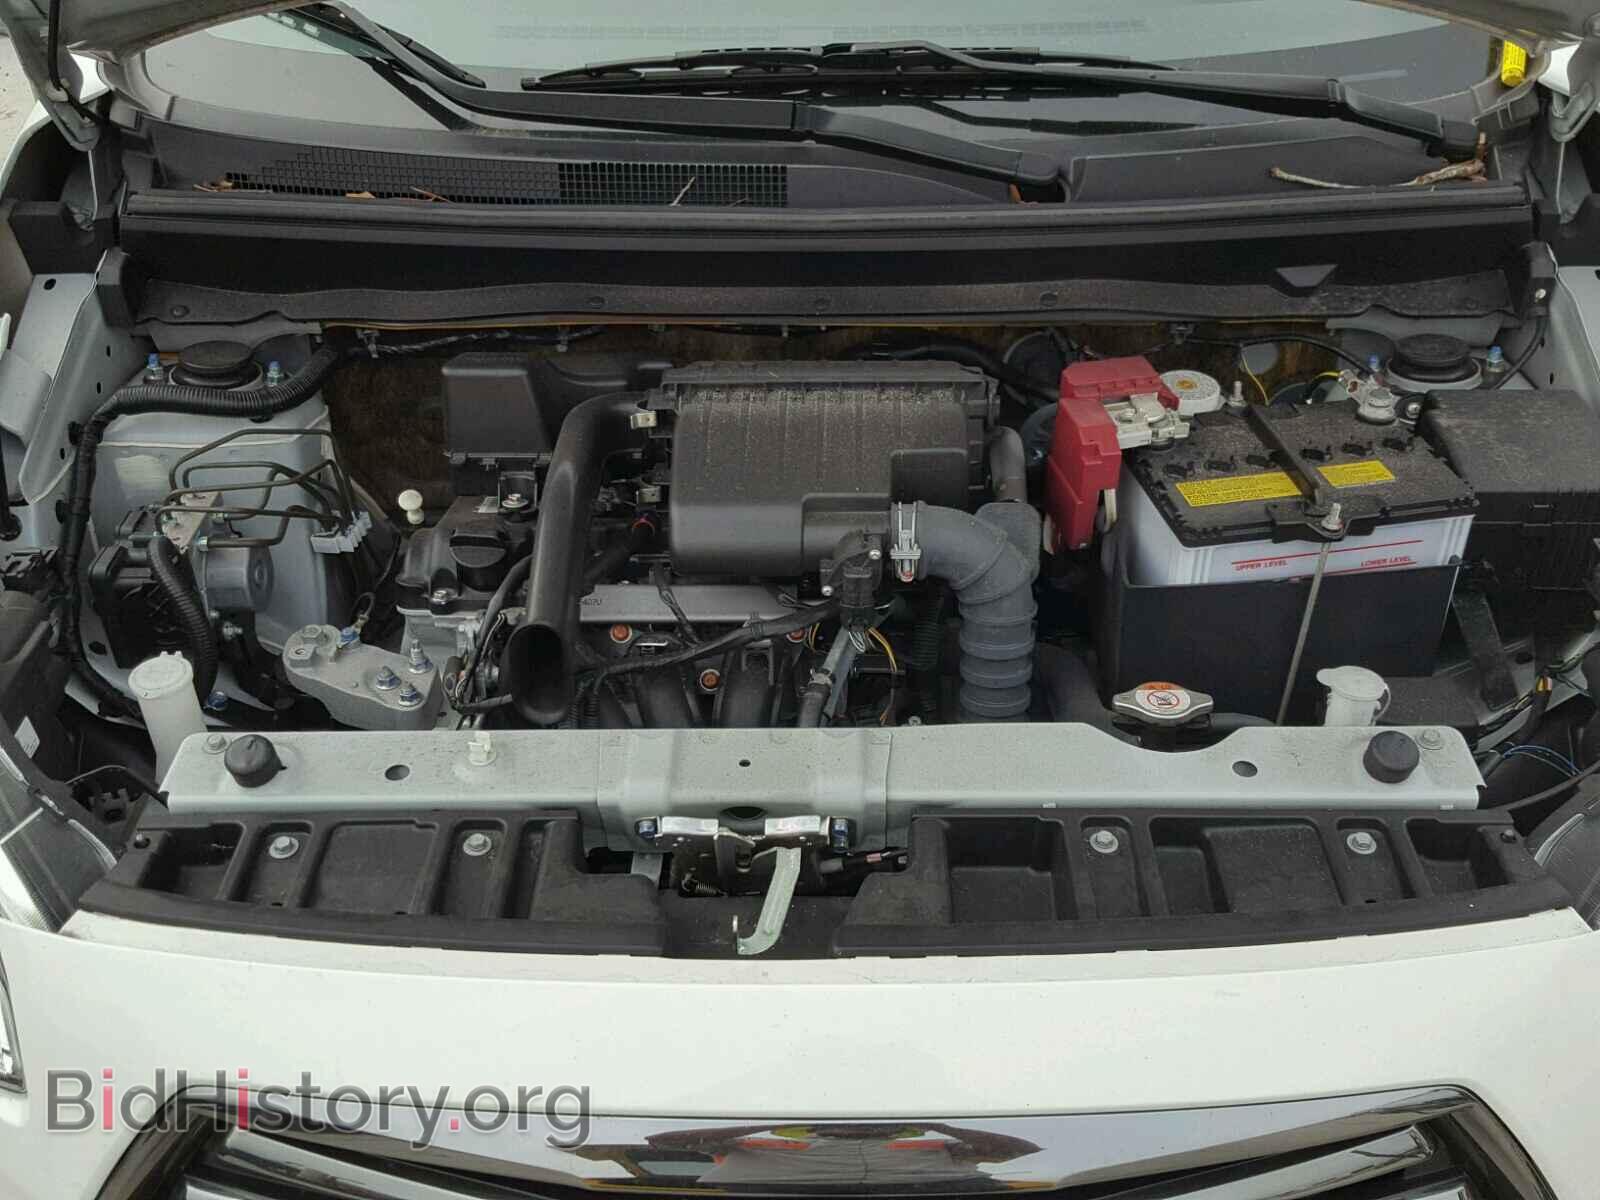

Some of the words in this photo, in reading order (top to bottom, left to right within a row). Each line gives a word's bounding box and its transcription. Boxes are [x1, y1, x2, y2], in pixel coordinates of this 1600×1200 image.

[1235, 561, 1262, 572] UPPER
[1263, 559, 1288, 569] LEVEL
[1360, 558, 1388, 568] LOWER
[1389, 555, 1412, 564] LEVEL
